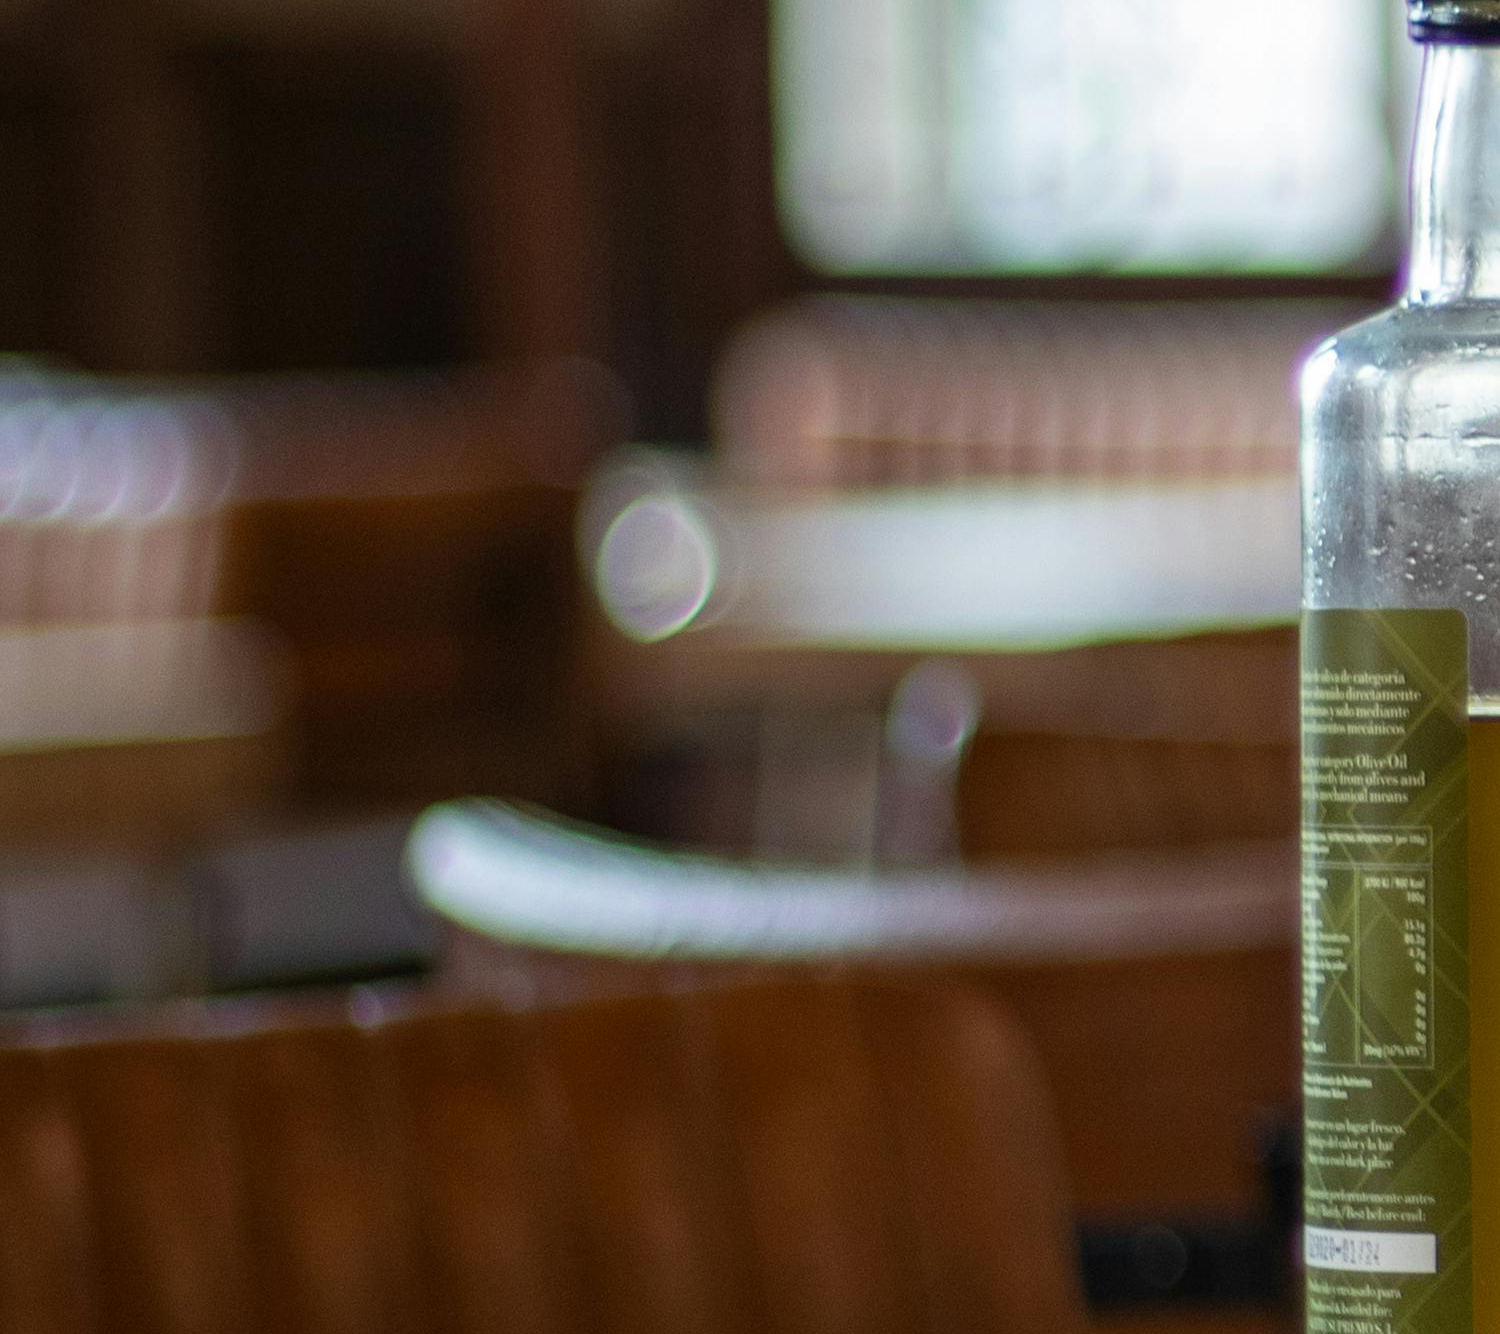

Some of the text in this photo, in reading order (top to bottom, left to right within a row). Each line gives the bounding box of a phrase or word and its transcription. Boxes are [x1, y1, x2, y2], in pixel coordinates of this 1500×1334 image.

[1346, 686, 1421, 701] directamente
[1356, 703, 1410, 718] mediante
[1355, 753, 1386, 769] Olive
[1387, 754, 1408, 769] Oil
[1338, 771, 1364, 786] from
[1365, 771, 1399, 786] olives
[1400, 771, 1425, 787] and
[1369, 792, 1409, 803] means
[1366, 1154, 1394, 1172] place
[1405, 1193, 1436, 1205] antes
[1366, 1206, 1401, 1221] before
[1377, 1288, 1402, 1301] para
